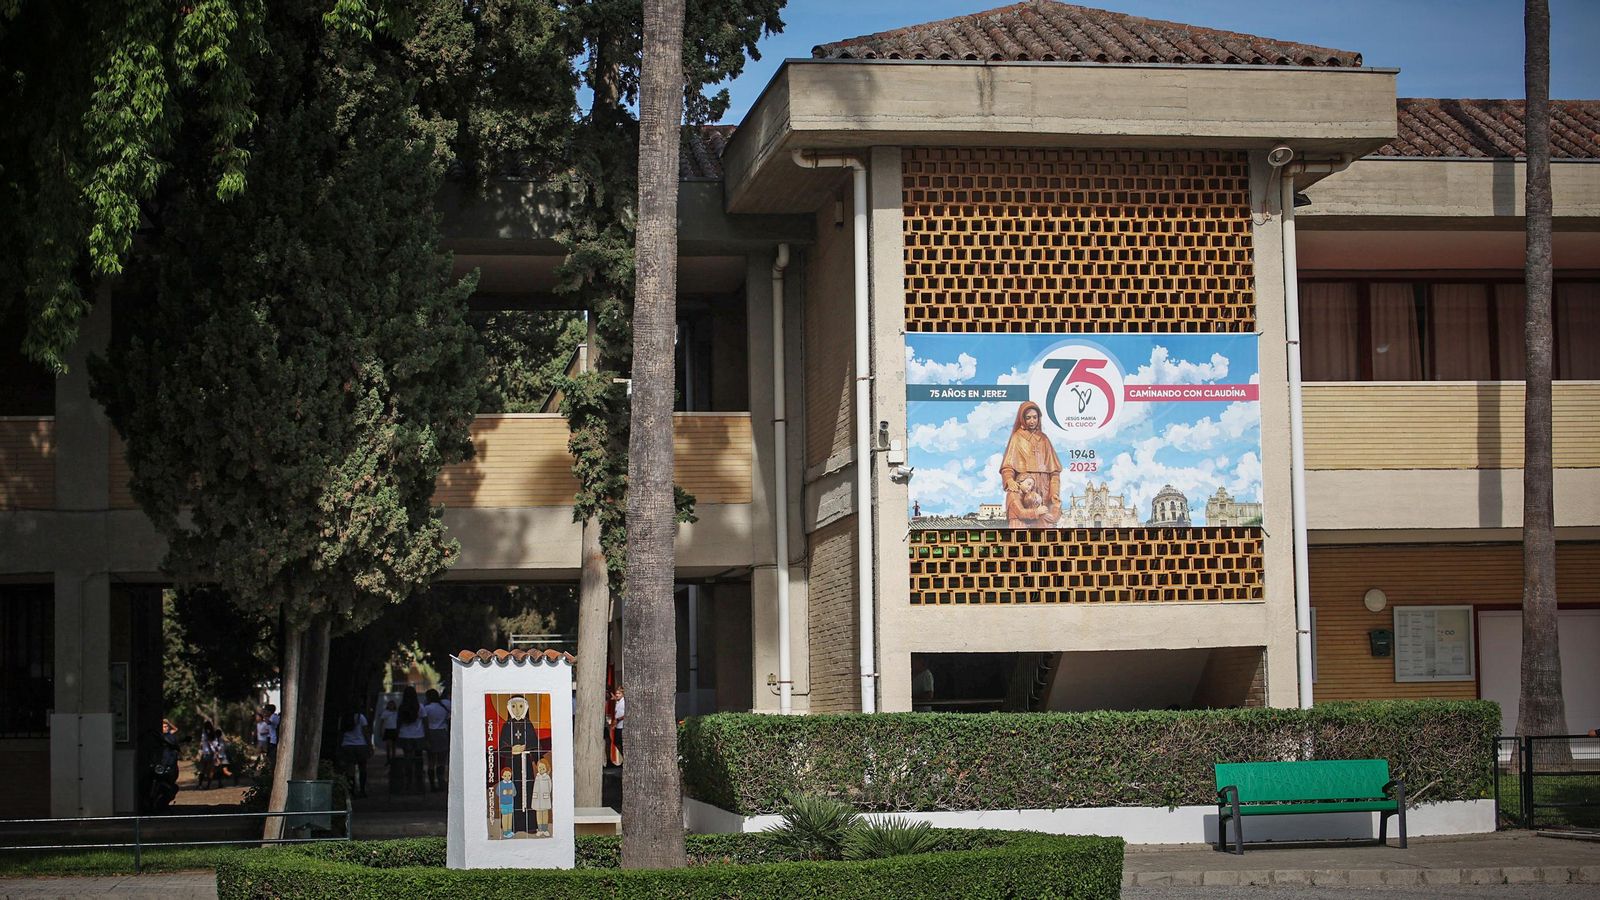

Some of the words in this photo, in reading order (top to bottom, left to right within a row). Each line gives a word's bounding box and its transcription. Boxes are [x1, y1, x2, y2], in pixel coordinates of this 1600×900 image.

[929, 389, 940, 398] 75
[941, 388, 966, 398] AÑOS
[968, 389, 979, 398] EN
[982, 389, 1007, 398] JEREZ
[1043, 358, 1116, 431] 75
[1183, 389, 1202, 398] CON
[1070, 449, 1096, 459] 1948
[1070, 462, 1097, 472] 2023
